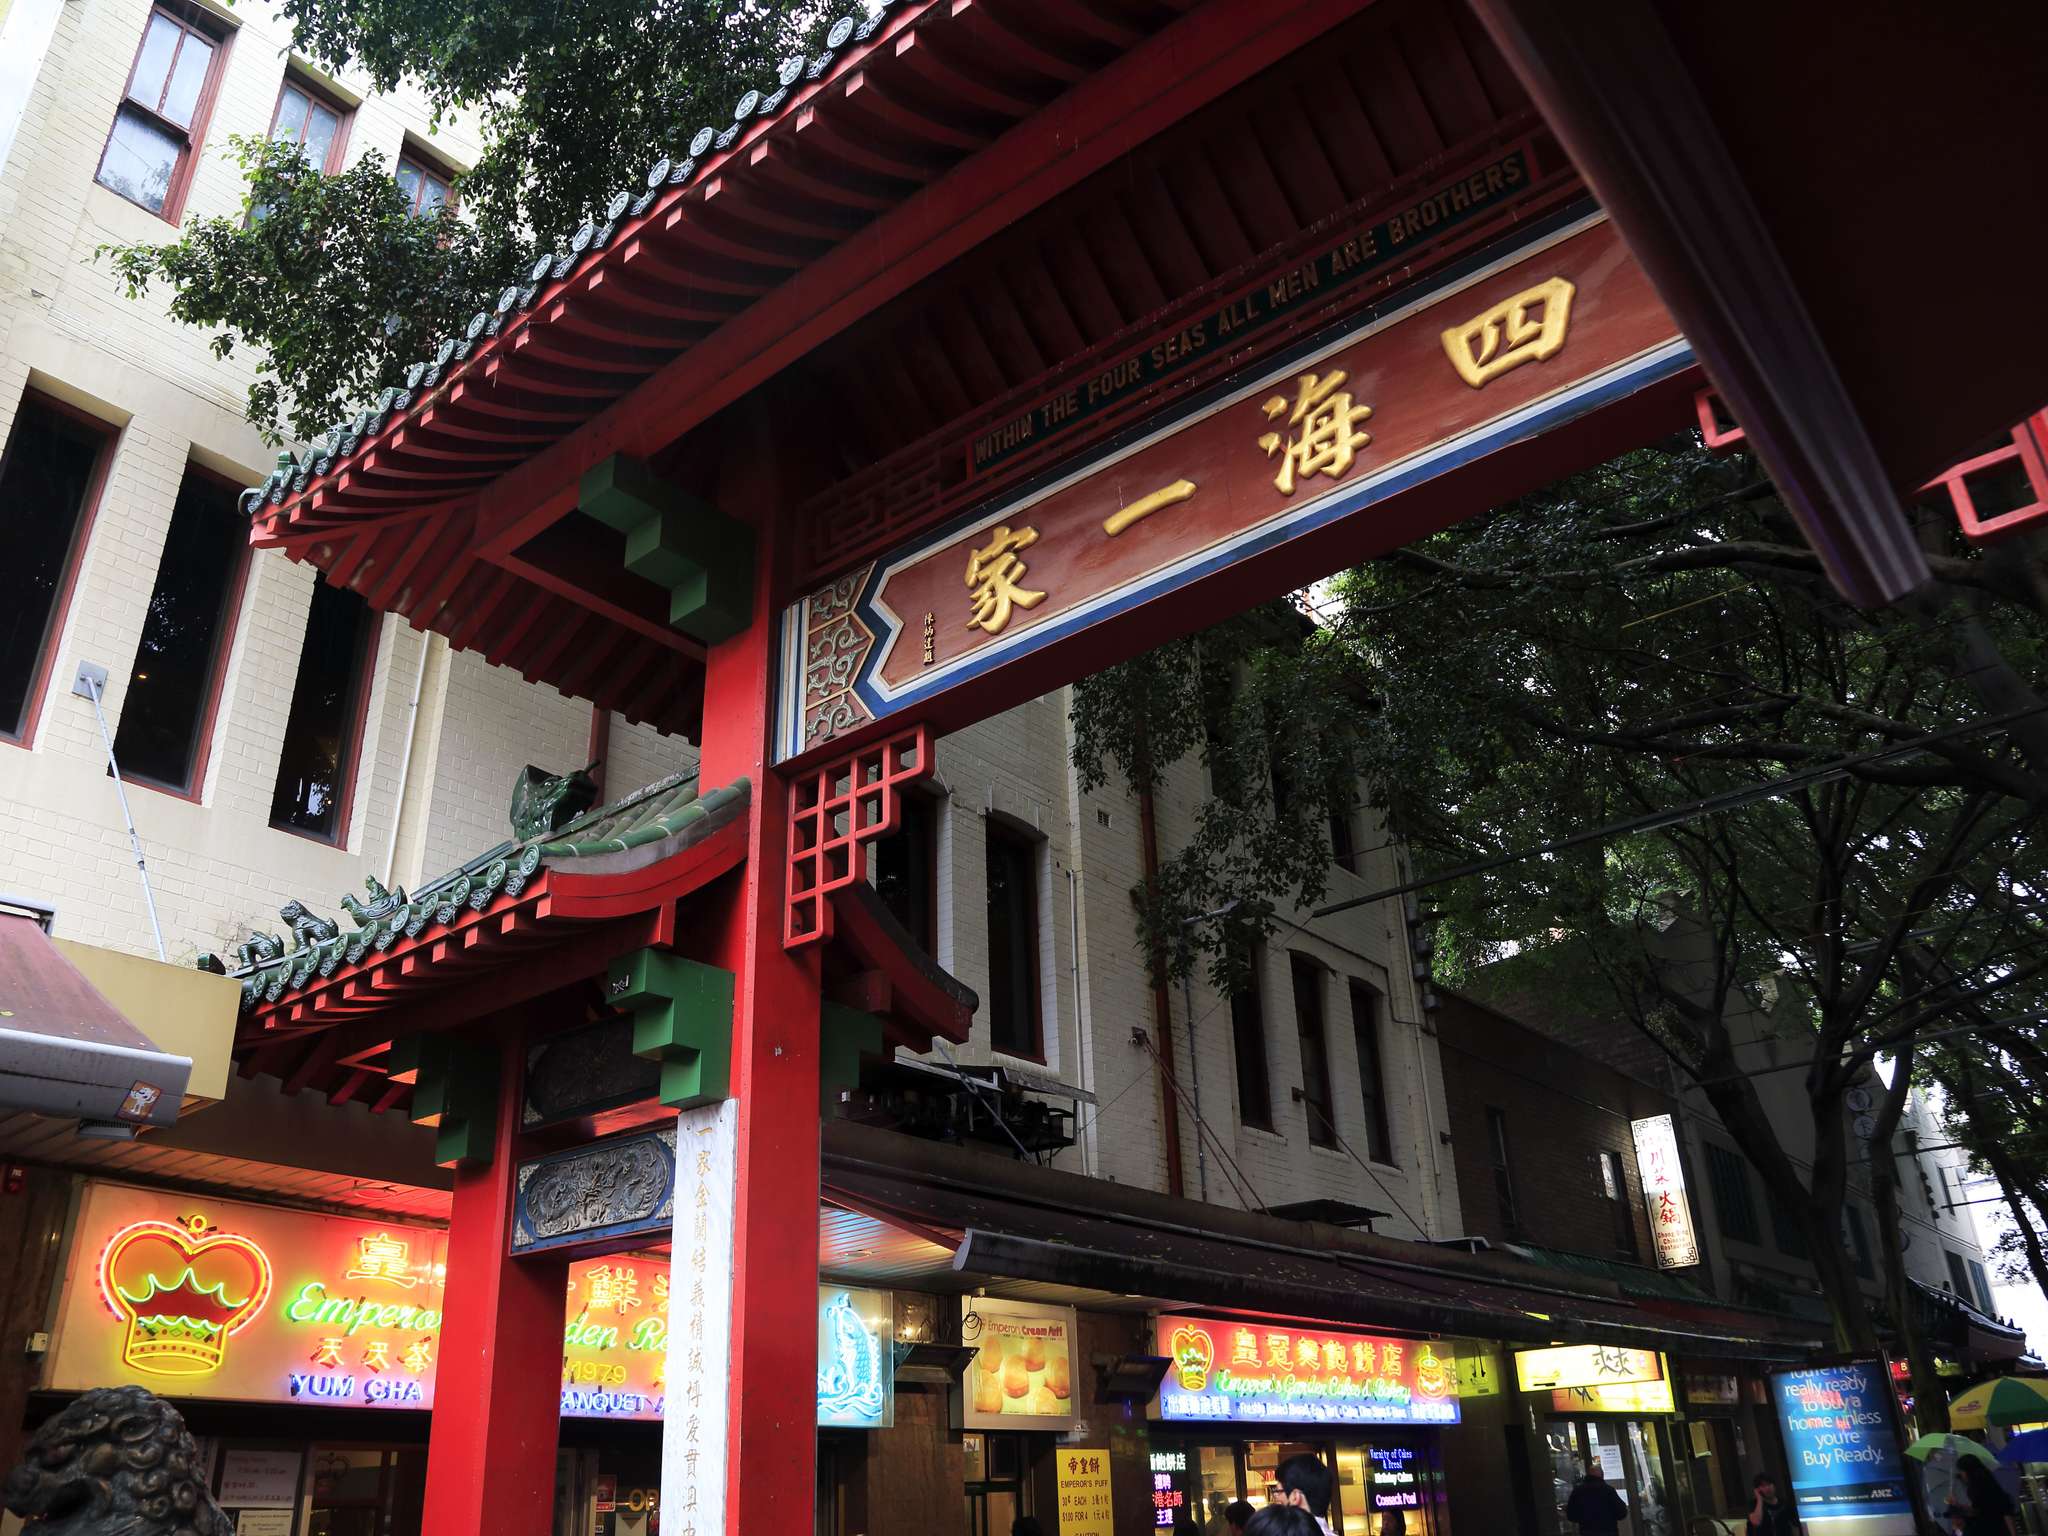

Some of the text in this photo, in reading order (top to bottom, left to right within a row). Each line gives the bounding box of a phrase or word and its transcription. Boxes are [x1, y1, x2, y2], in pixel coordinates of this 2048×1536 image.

[975, 156, 1523, 465] WITHIN THE FOUR SEAS ALL MEN ARE BROTHERS
[572, 1361, 627, 1385] 1979
[291, 1374, 425, 1401] YUM CHA
[1785, 1374, 1867, 1398] really ready
[1801, 1399, 1818, 1412] to
[1852, 1395, 1862, 1408] a
[1788, 1411, 1882, 1431] home unless
[1803, 1450, 1832, 1468] Buy
[1060, 1480, 1107, 1489] EMPEROR'S PUFF
[1871, 1488, 1893, 1498] ANZ
